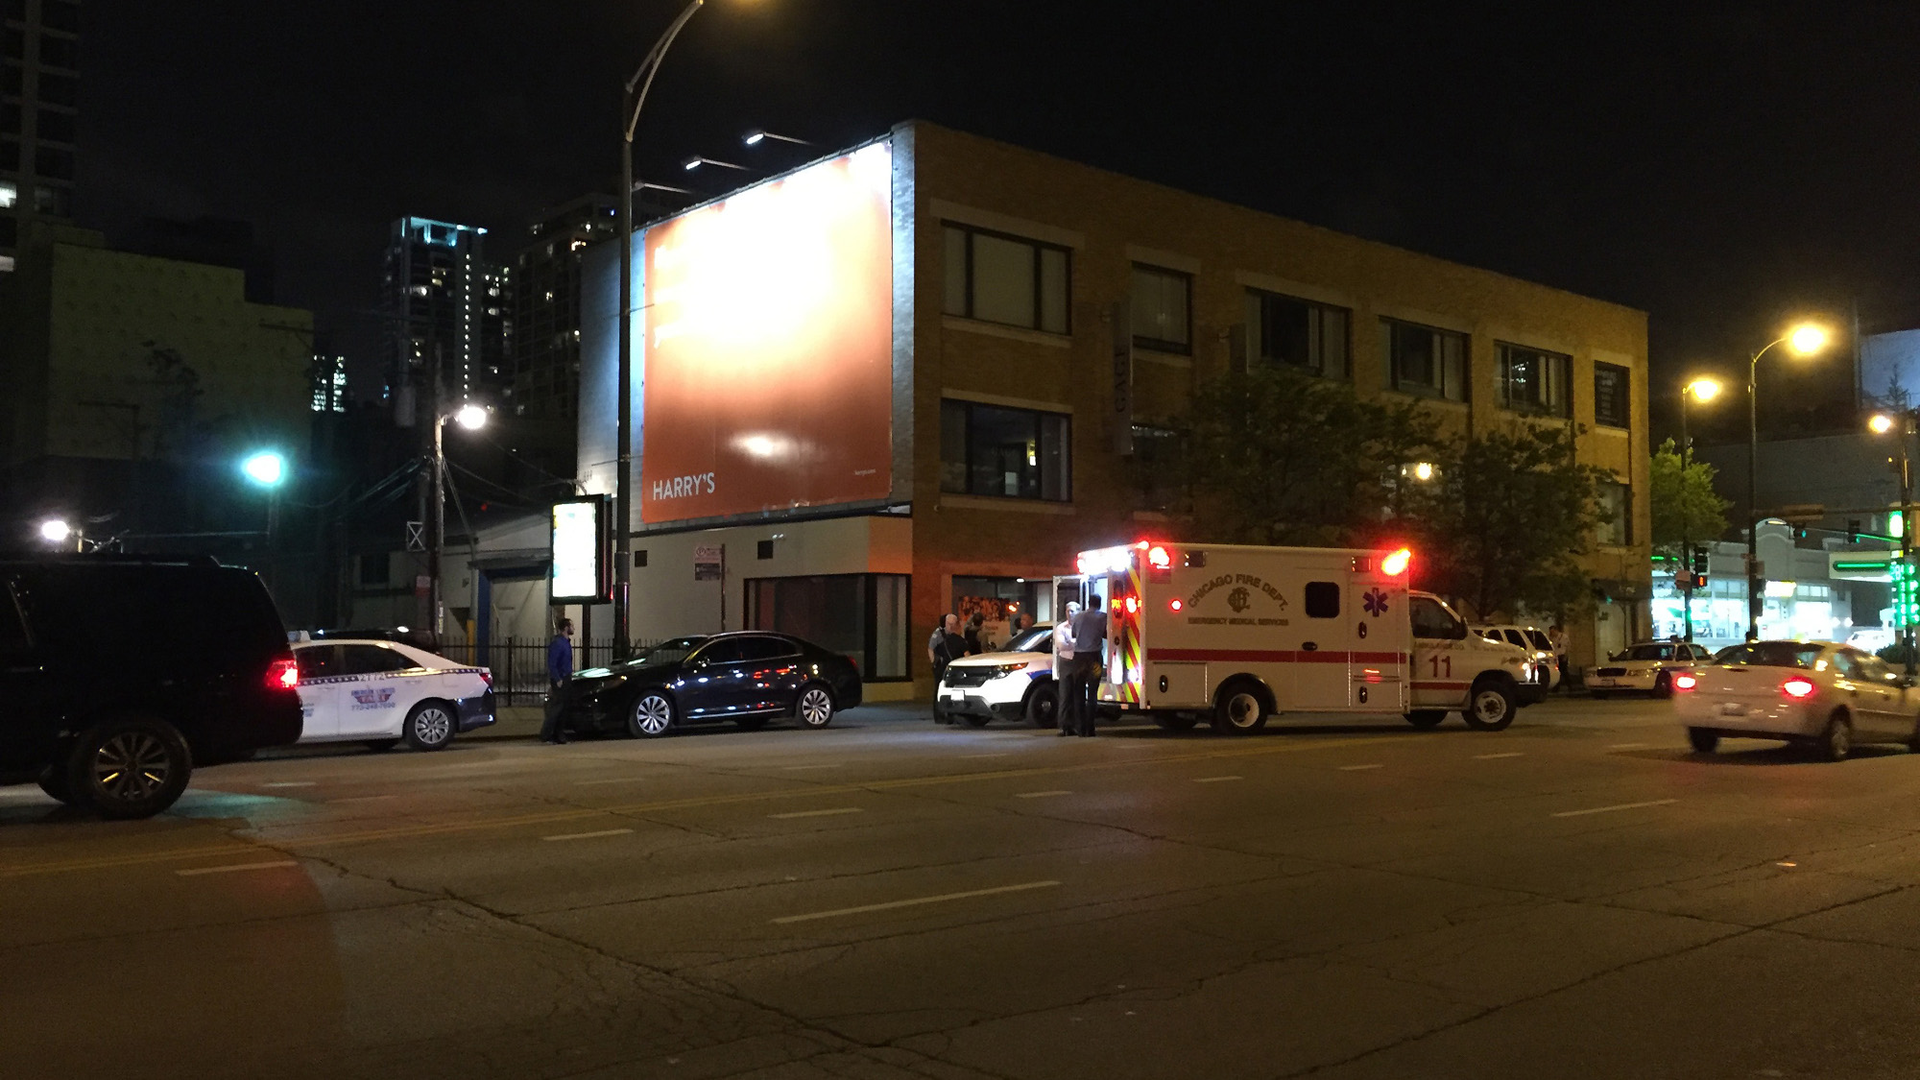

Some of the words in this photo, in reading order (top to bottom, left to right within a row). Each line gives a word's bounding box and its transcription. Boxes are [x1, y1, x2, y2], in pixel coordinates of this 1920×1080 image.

[652, 472, 716, 501] HARRY'S
[1187, 573, 1234, 608] CHICAGO
[1235, 573, 1262, 588] FIRE
[1261, 582, 1289, 611] DEPT.
[1429, 655, 1452, 678] 11
